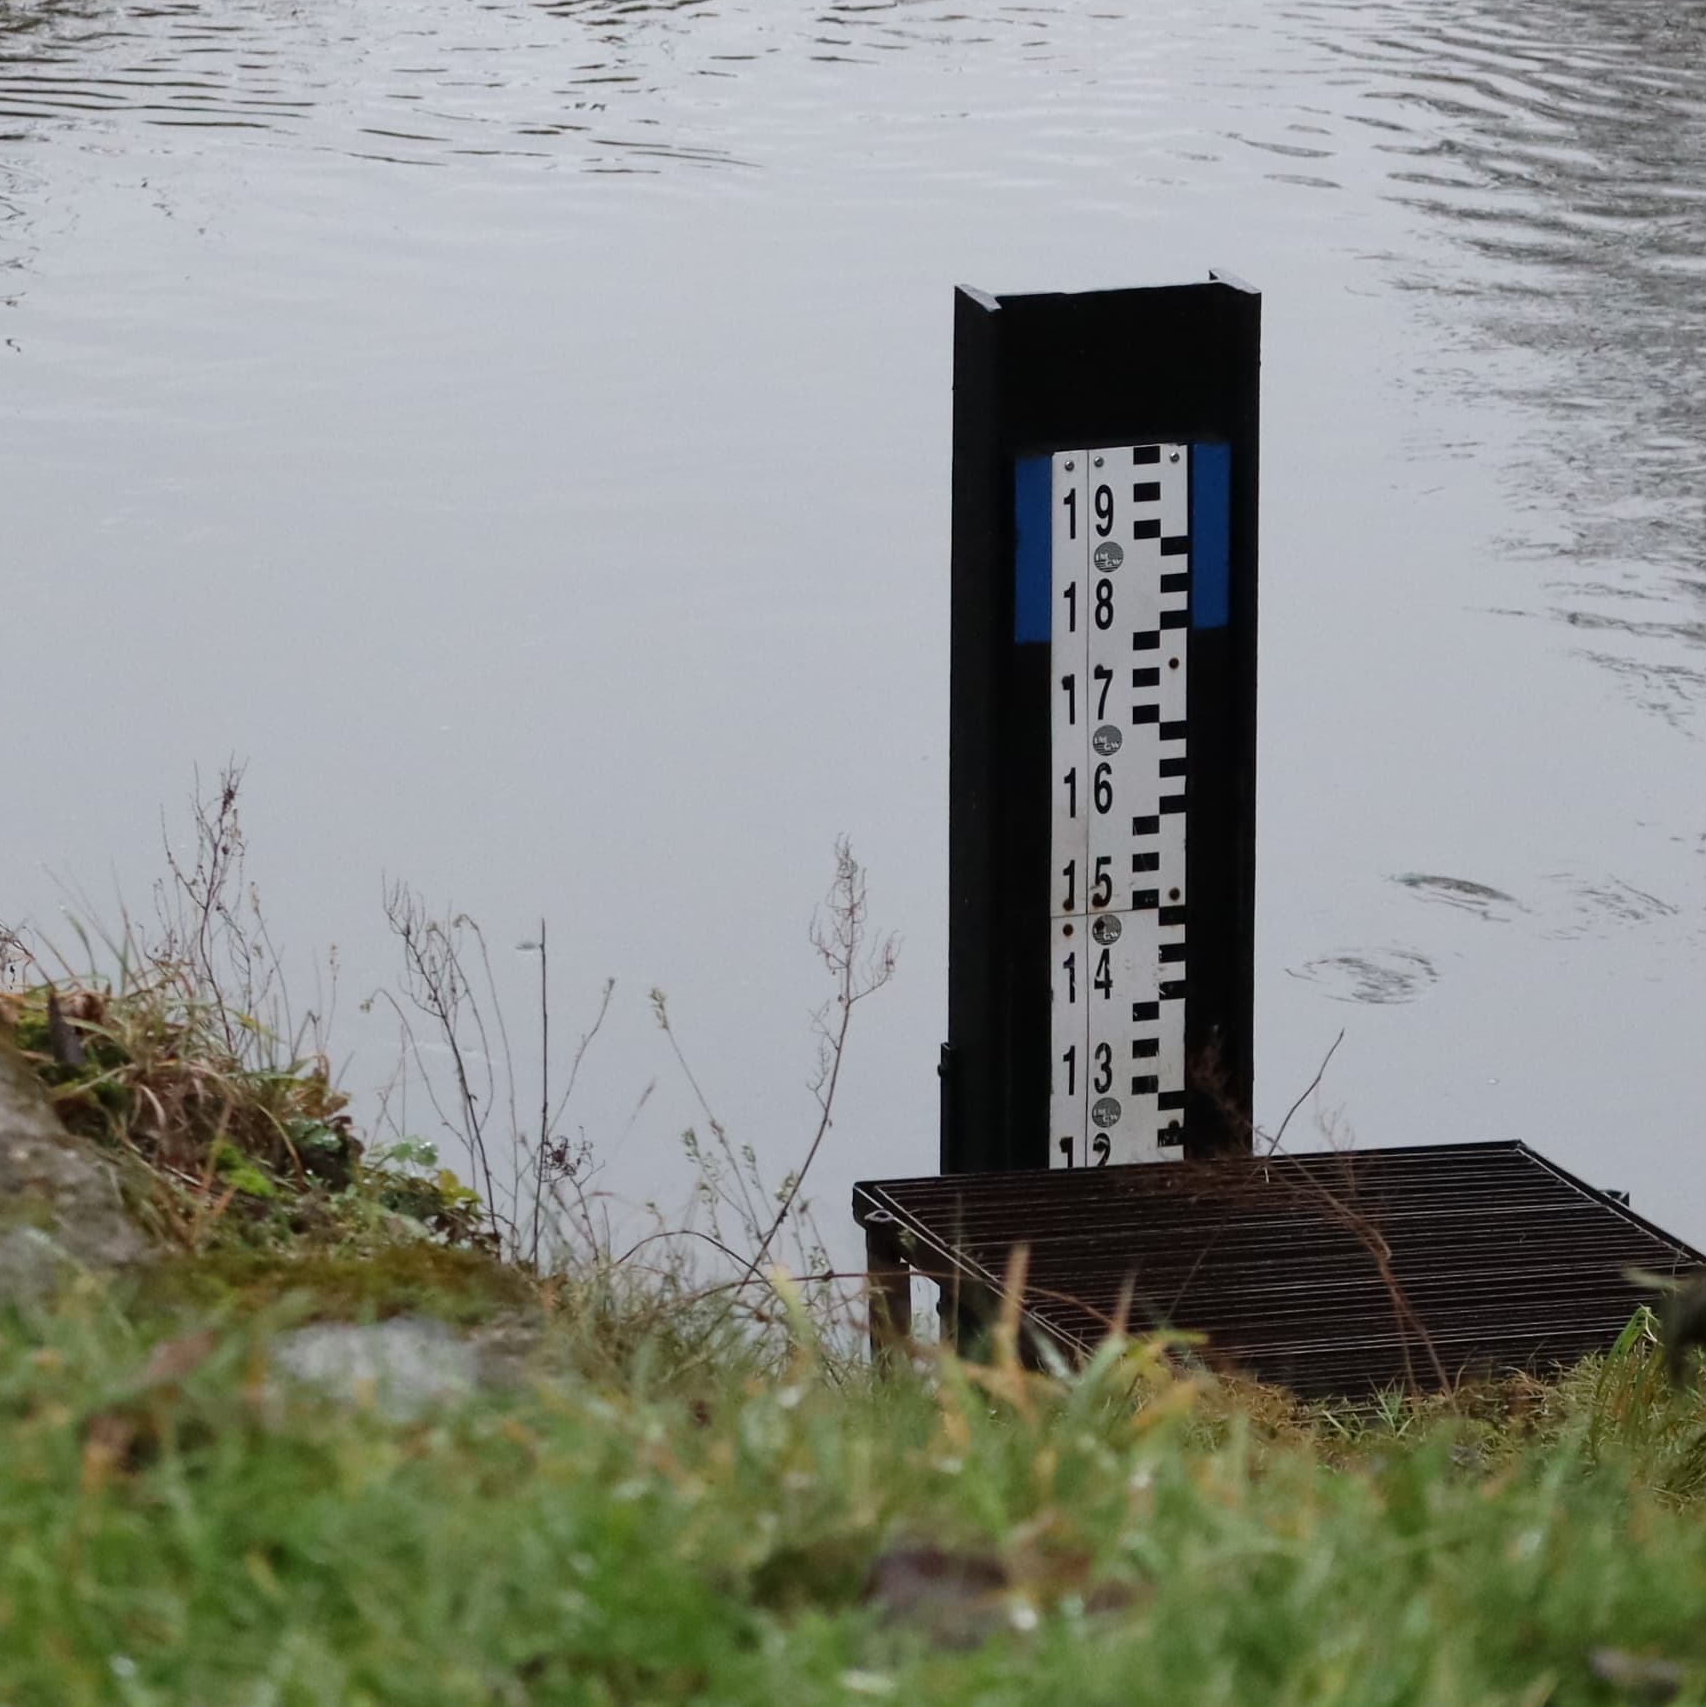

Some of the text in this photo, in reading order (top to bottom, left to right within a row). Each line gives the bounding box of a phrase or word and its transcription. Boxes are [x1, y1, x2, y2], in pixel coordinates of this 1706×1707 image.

[1063, 484, 1114, 540] 19
[1063, 578, 1114, 633] 18
[1061, 663, 1114, 725] 17
[1063, 761, 1113, 819] 16
[1062, 855, 1113, 912] 15
[1062, 948, 1114, 1004] 14
[1062, 1040, 1113, 1098] 13
